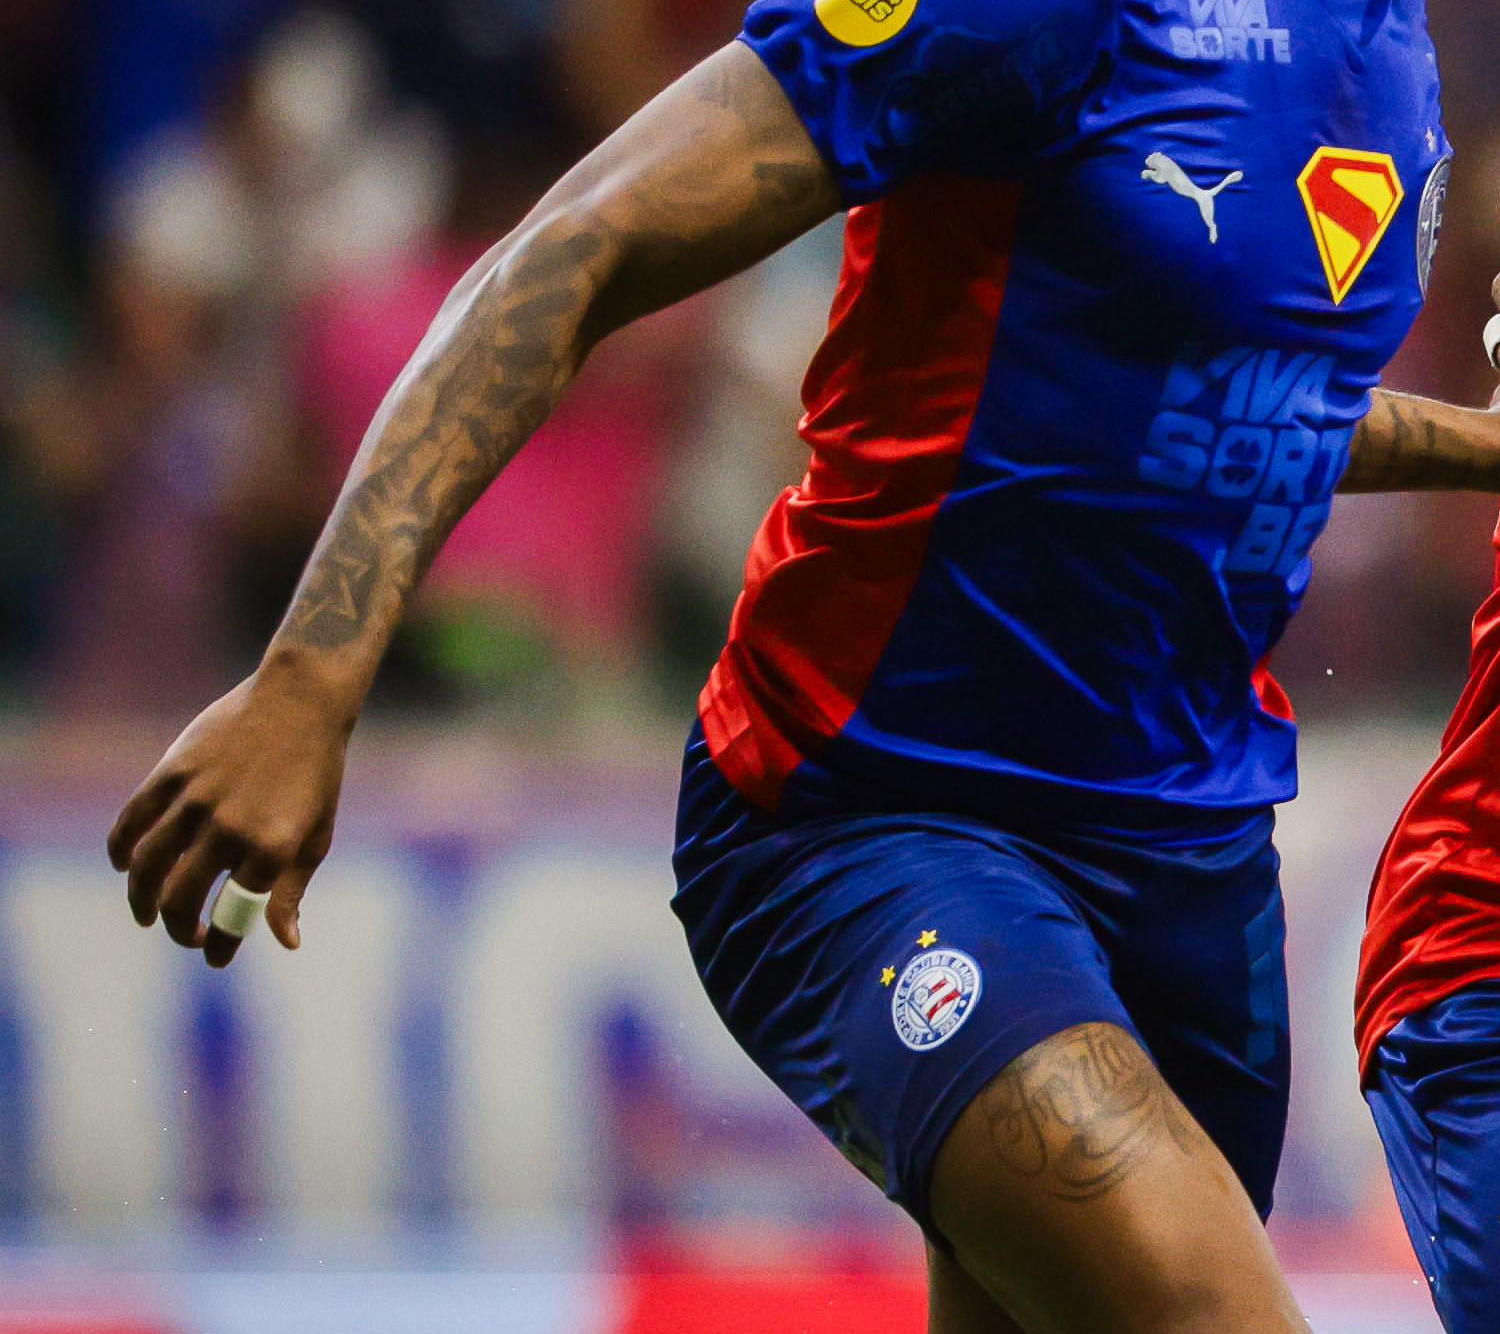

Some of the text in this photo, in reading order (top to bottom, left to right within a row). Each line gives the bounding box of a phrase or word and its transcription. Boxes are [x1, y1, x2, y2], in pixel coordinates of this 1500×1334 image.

[1169, 27, 1292, 63] SORTE
[1157, 338, 1340, 420] VIVA
[1137, 410, 1353, 505] SORT
[1211, 503, 1331, 574] .BE
